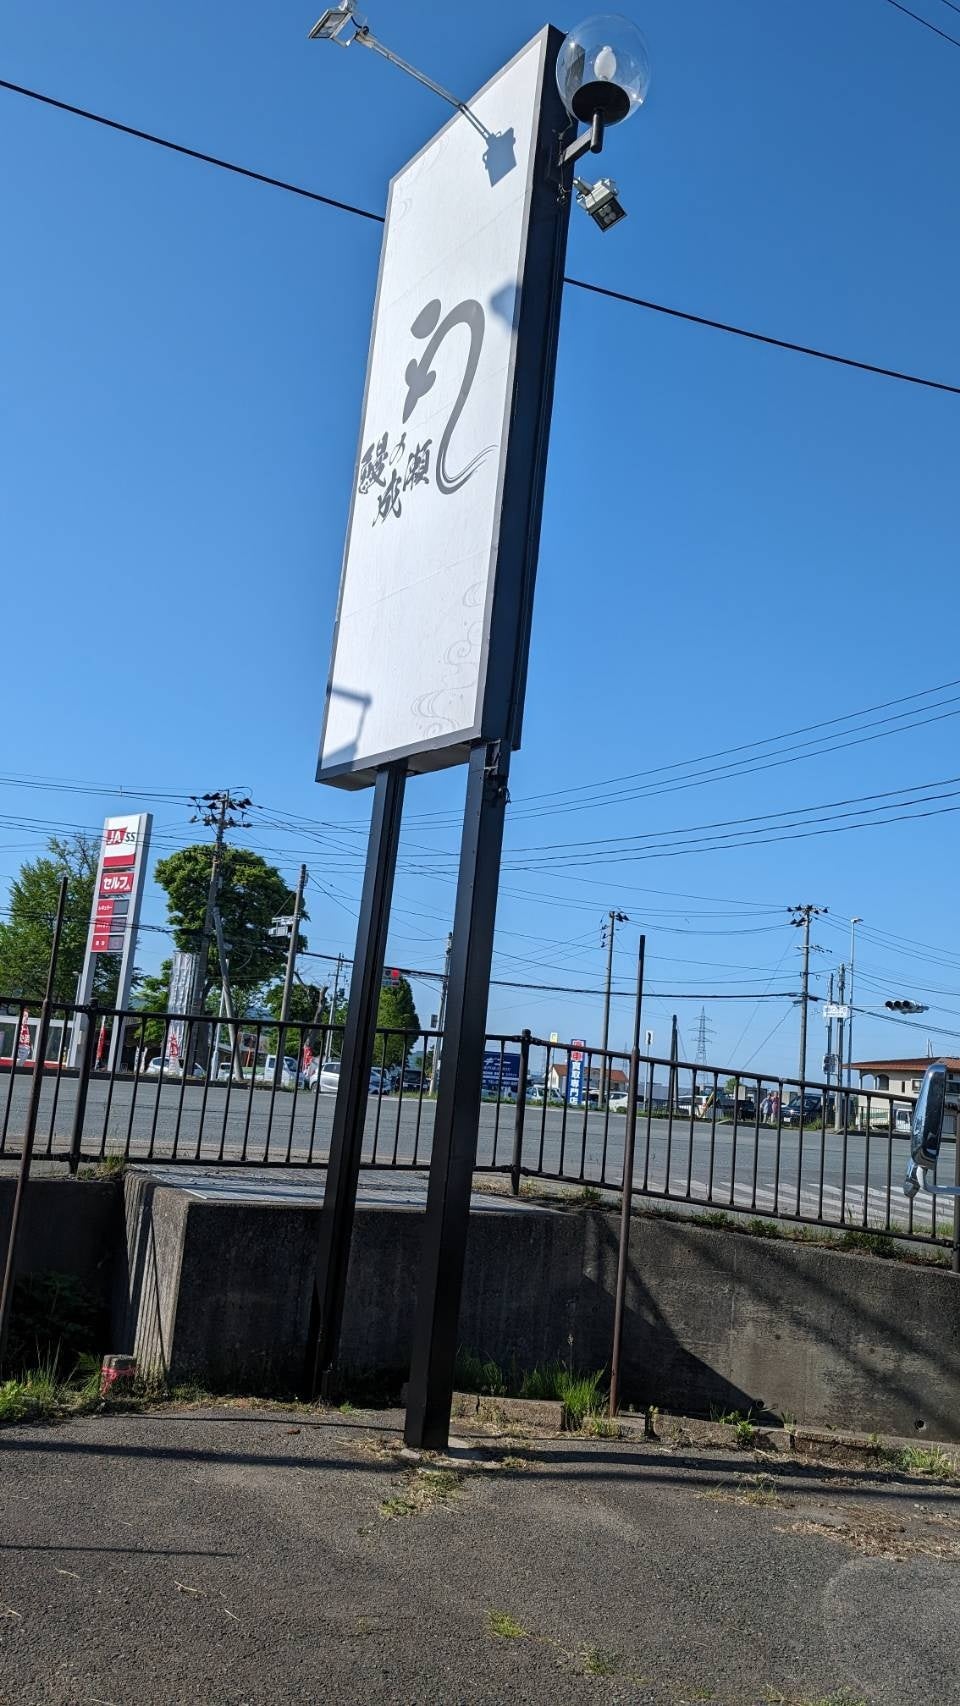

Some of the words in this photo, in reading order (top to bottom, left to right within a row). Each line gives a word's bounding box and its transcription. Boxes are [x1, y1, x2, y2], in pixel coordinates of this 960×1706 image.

[107, 830, 122, 844] JA
[125, 831, 137, 843] SS
[103, 876, 128, 891] セルフ
